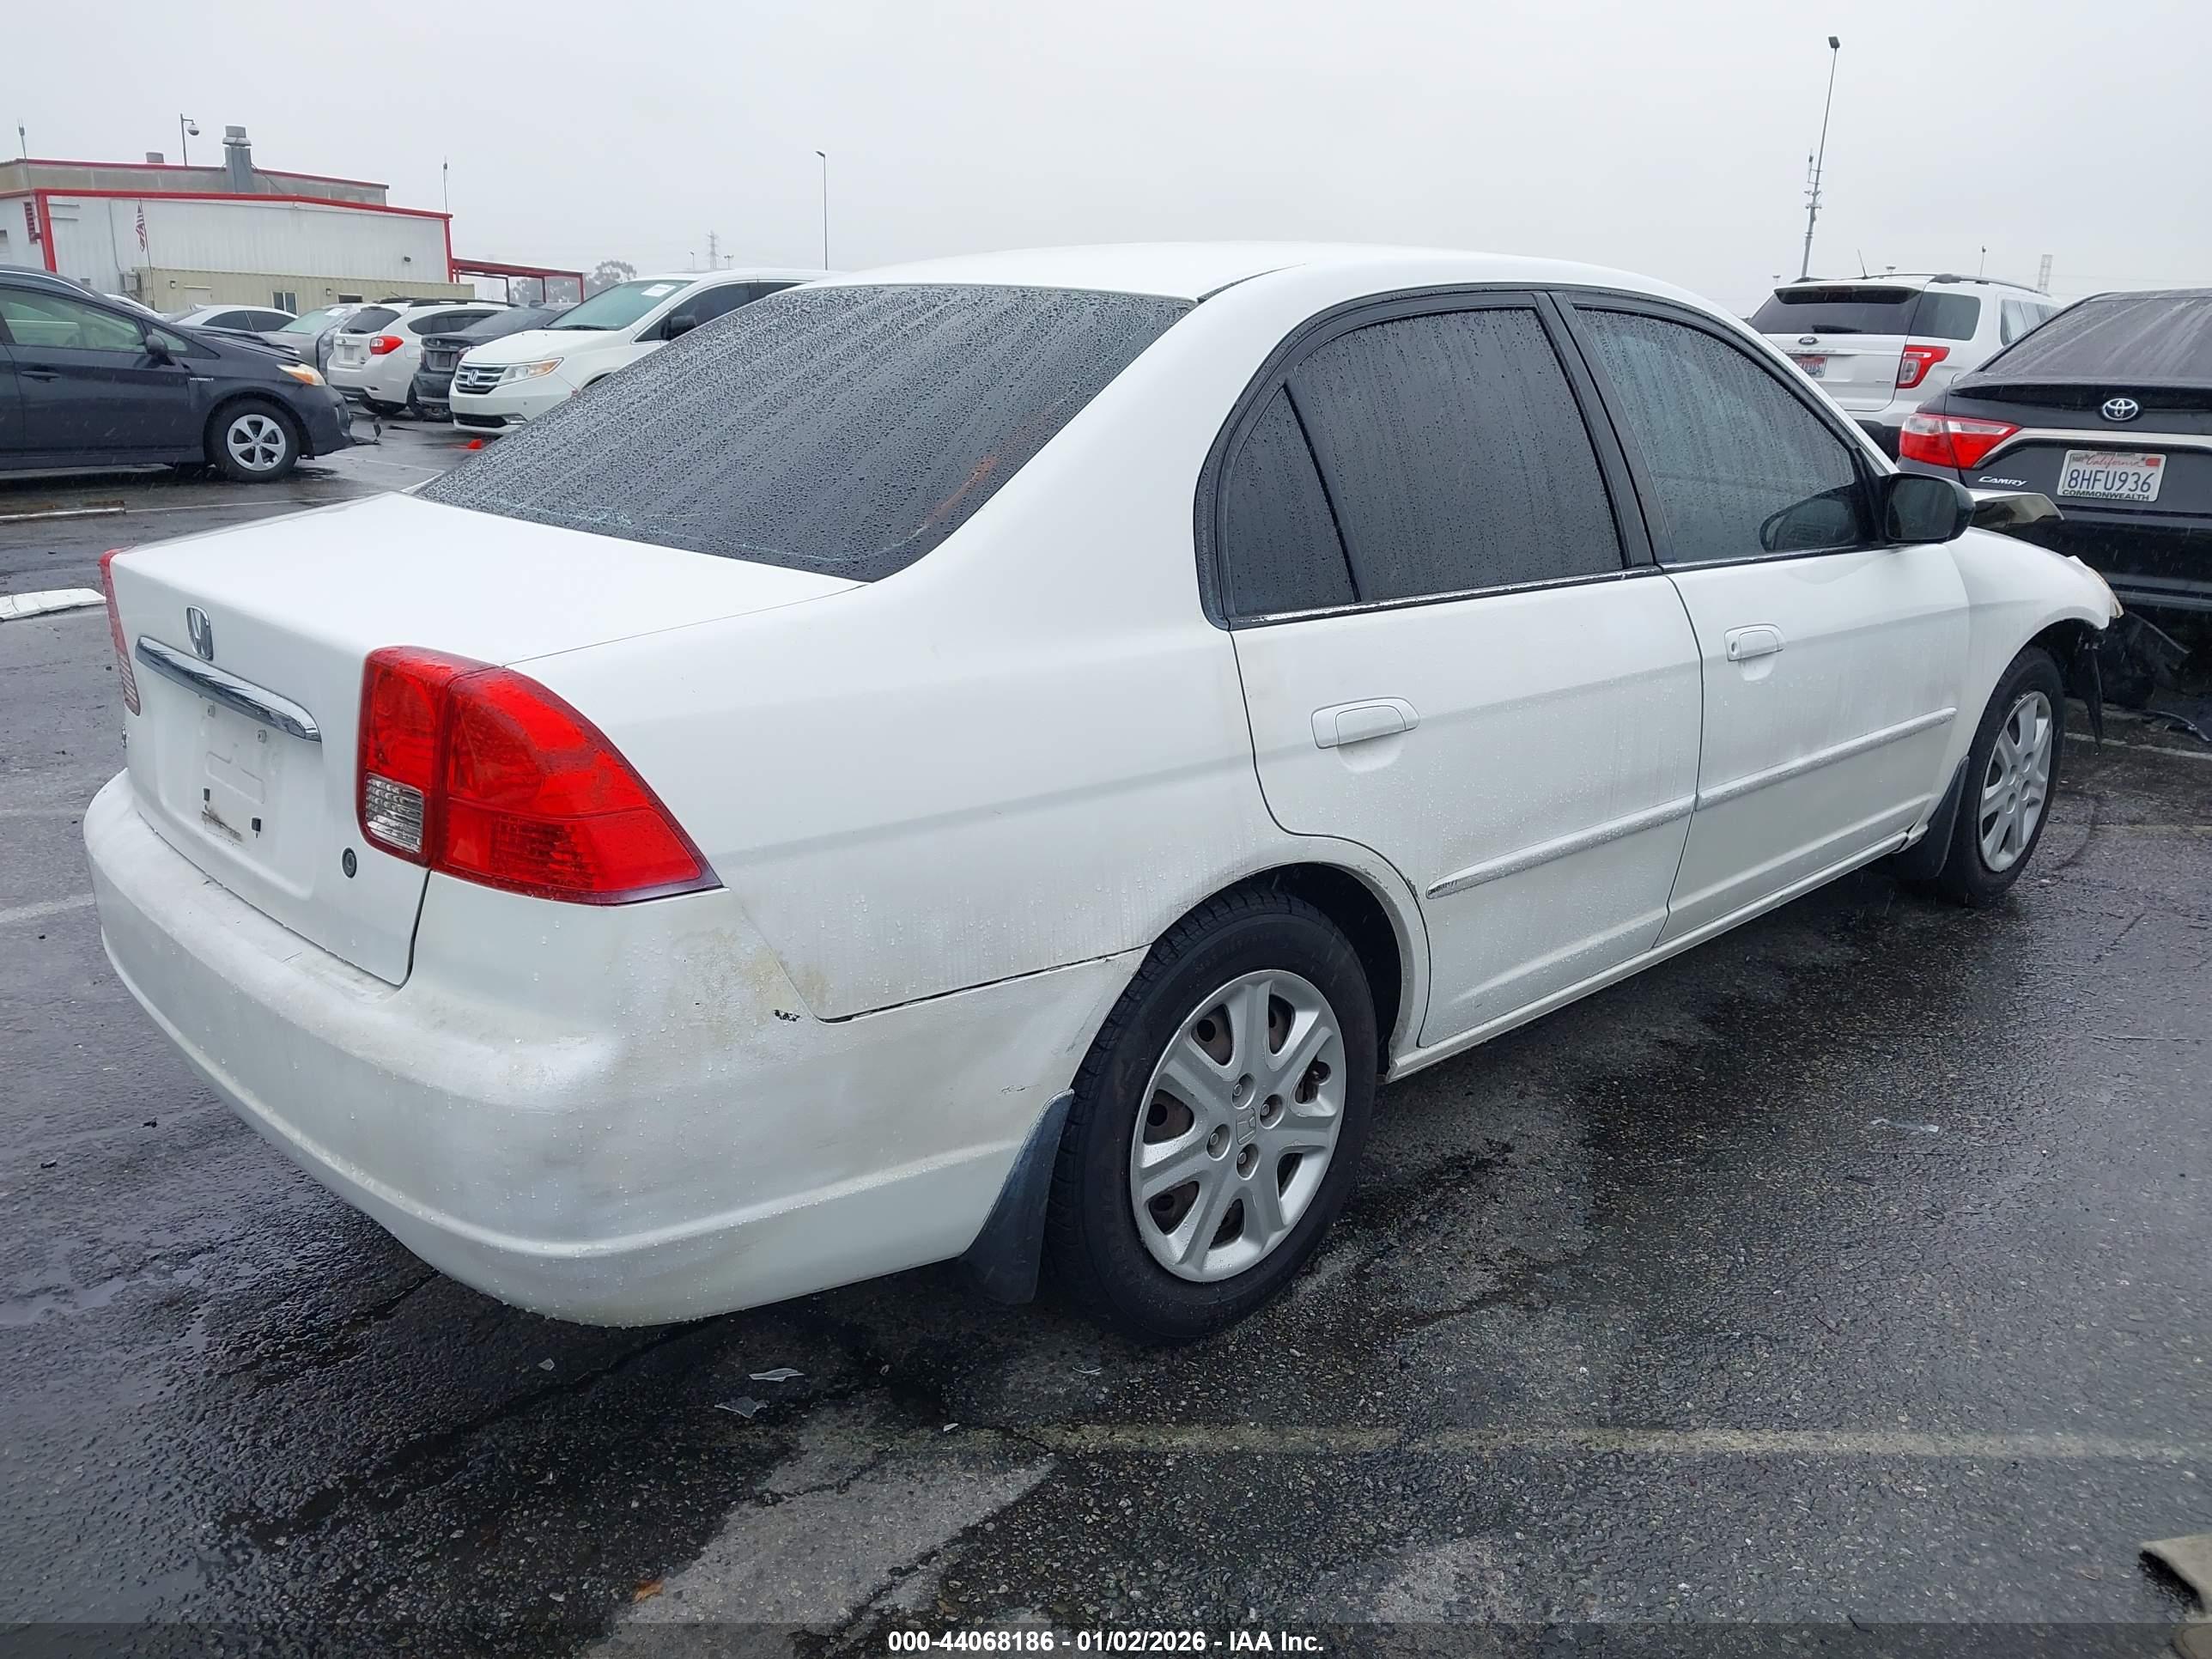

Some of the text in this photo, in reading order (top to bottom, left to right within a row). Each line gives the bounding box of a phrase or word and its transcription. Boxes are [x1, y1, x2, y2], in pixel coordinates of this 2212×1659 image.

[2086, 453, 2145, 469] California
[1978, 476, 2027, 487] CAMRY
[2067, 468, 2155, 494] 8HFU936
[2062, 489, 2150, 501] COMMONWEALTH
